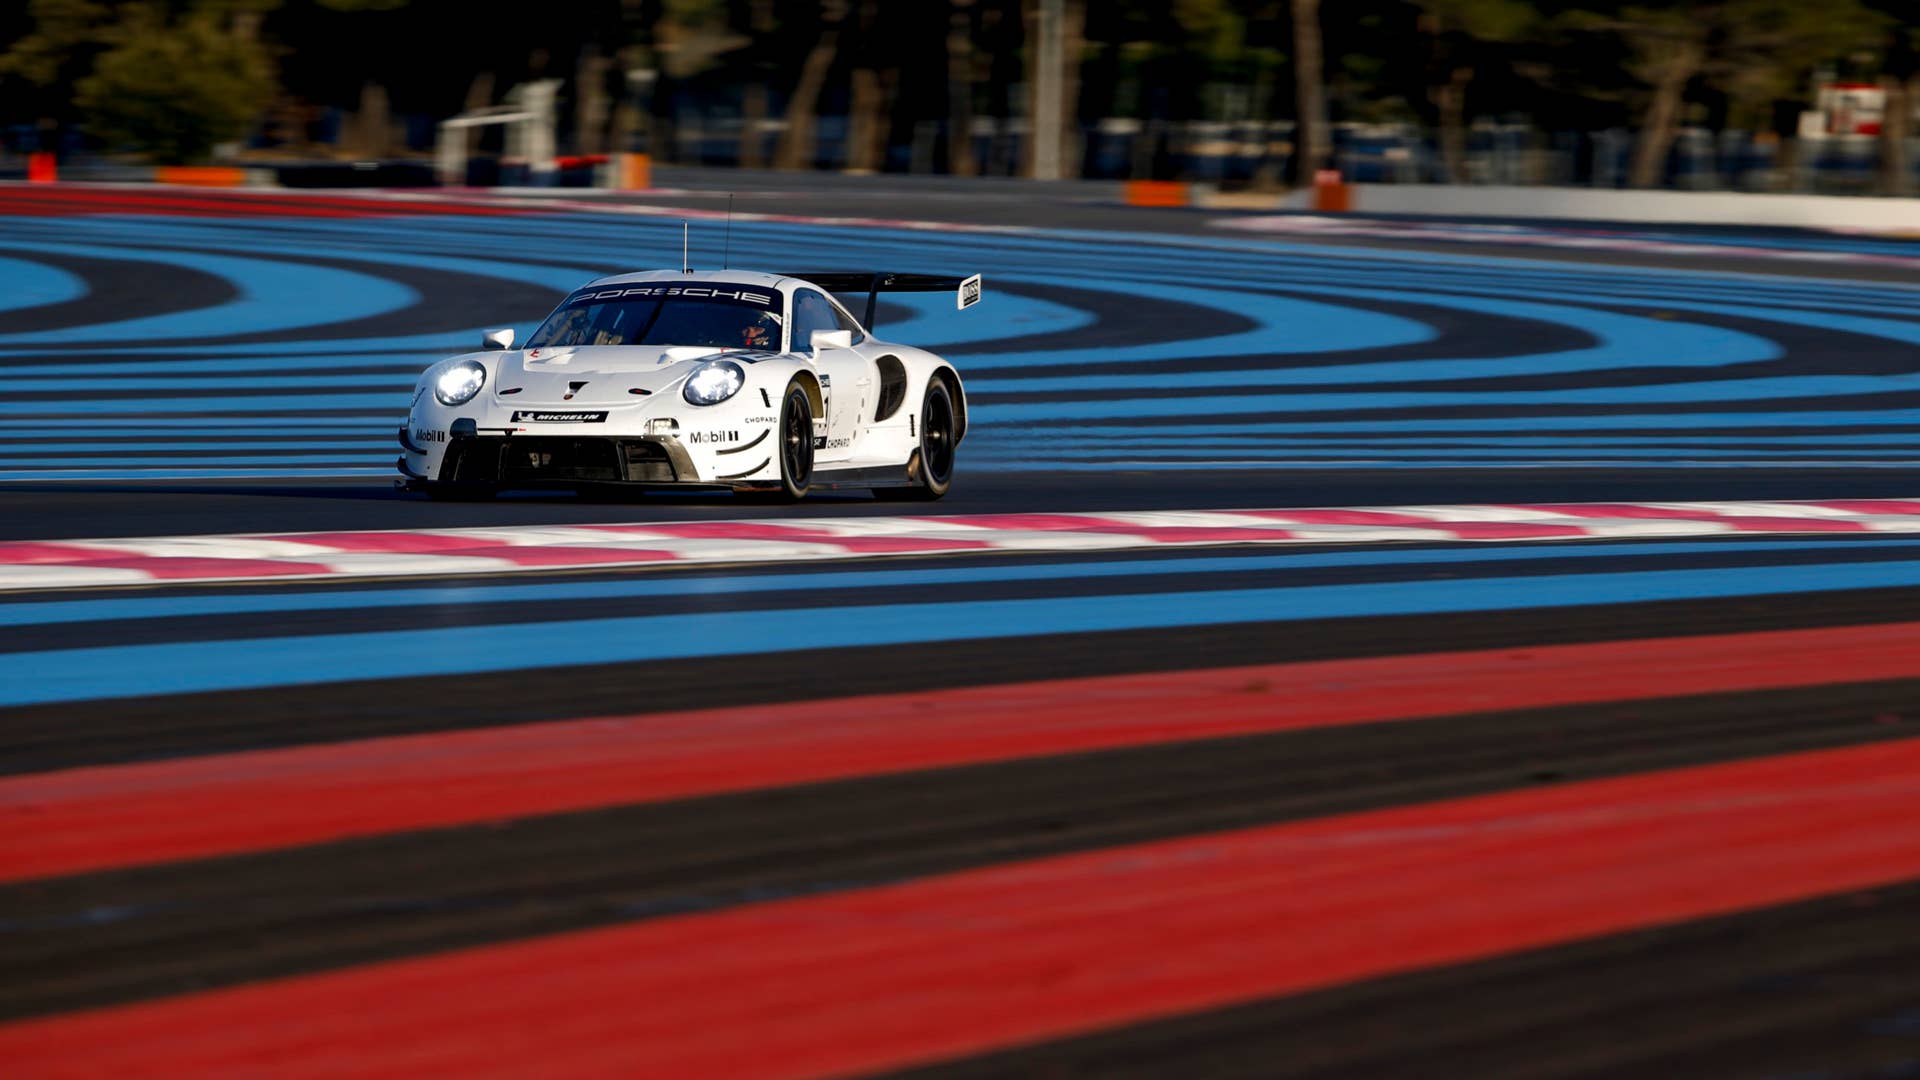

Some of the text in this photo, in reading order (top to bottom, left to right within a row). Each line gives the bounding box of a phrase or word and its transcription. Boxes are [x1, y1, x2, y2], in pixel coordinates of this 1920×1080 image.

[569, 287, 771, 305] PORSCHE
[536, 413, 600, 421] MICHELIN
[744, 416, 778, 424] CHOPARD
[415, 429, 436, 442] Mobil
[689, 430, 726, 444] Mobil
